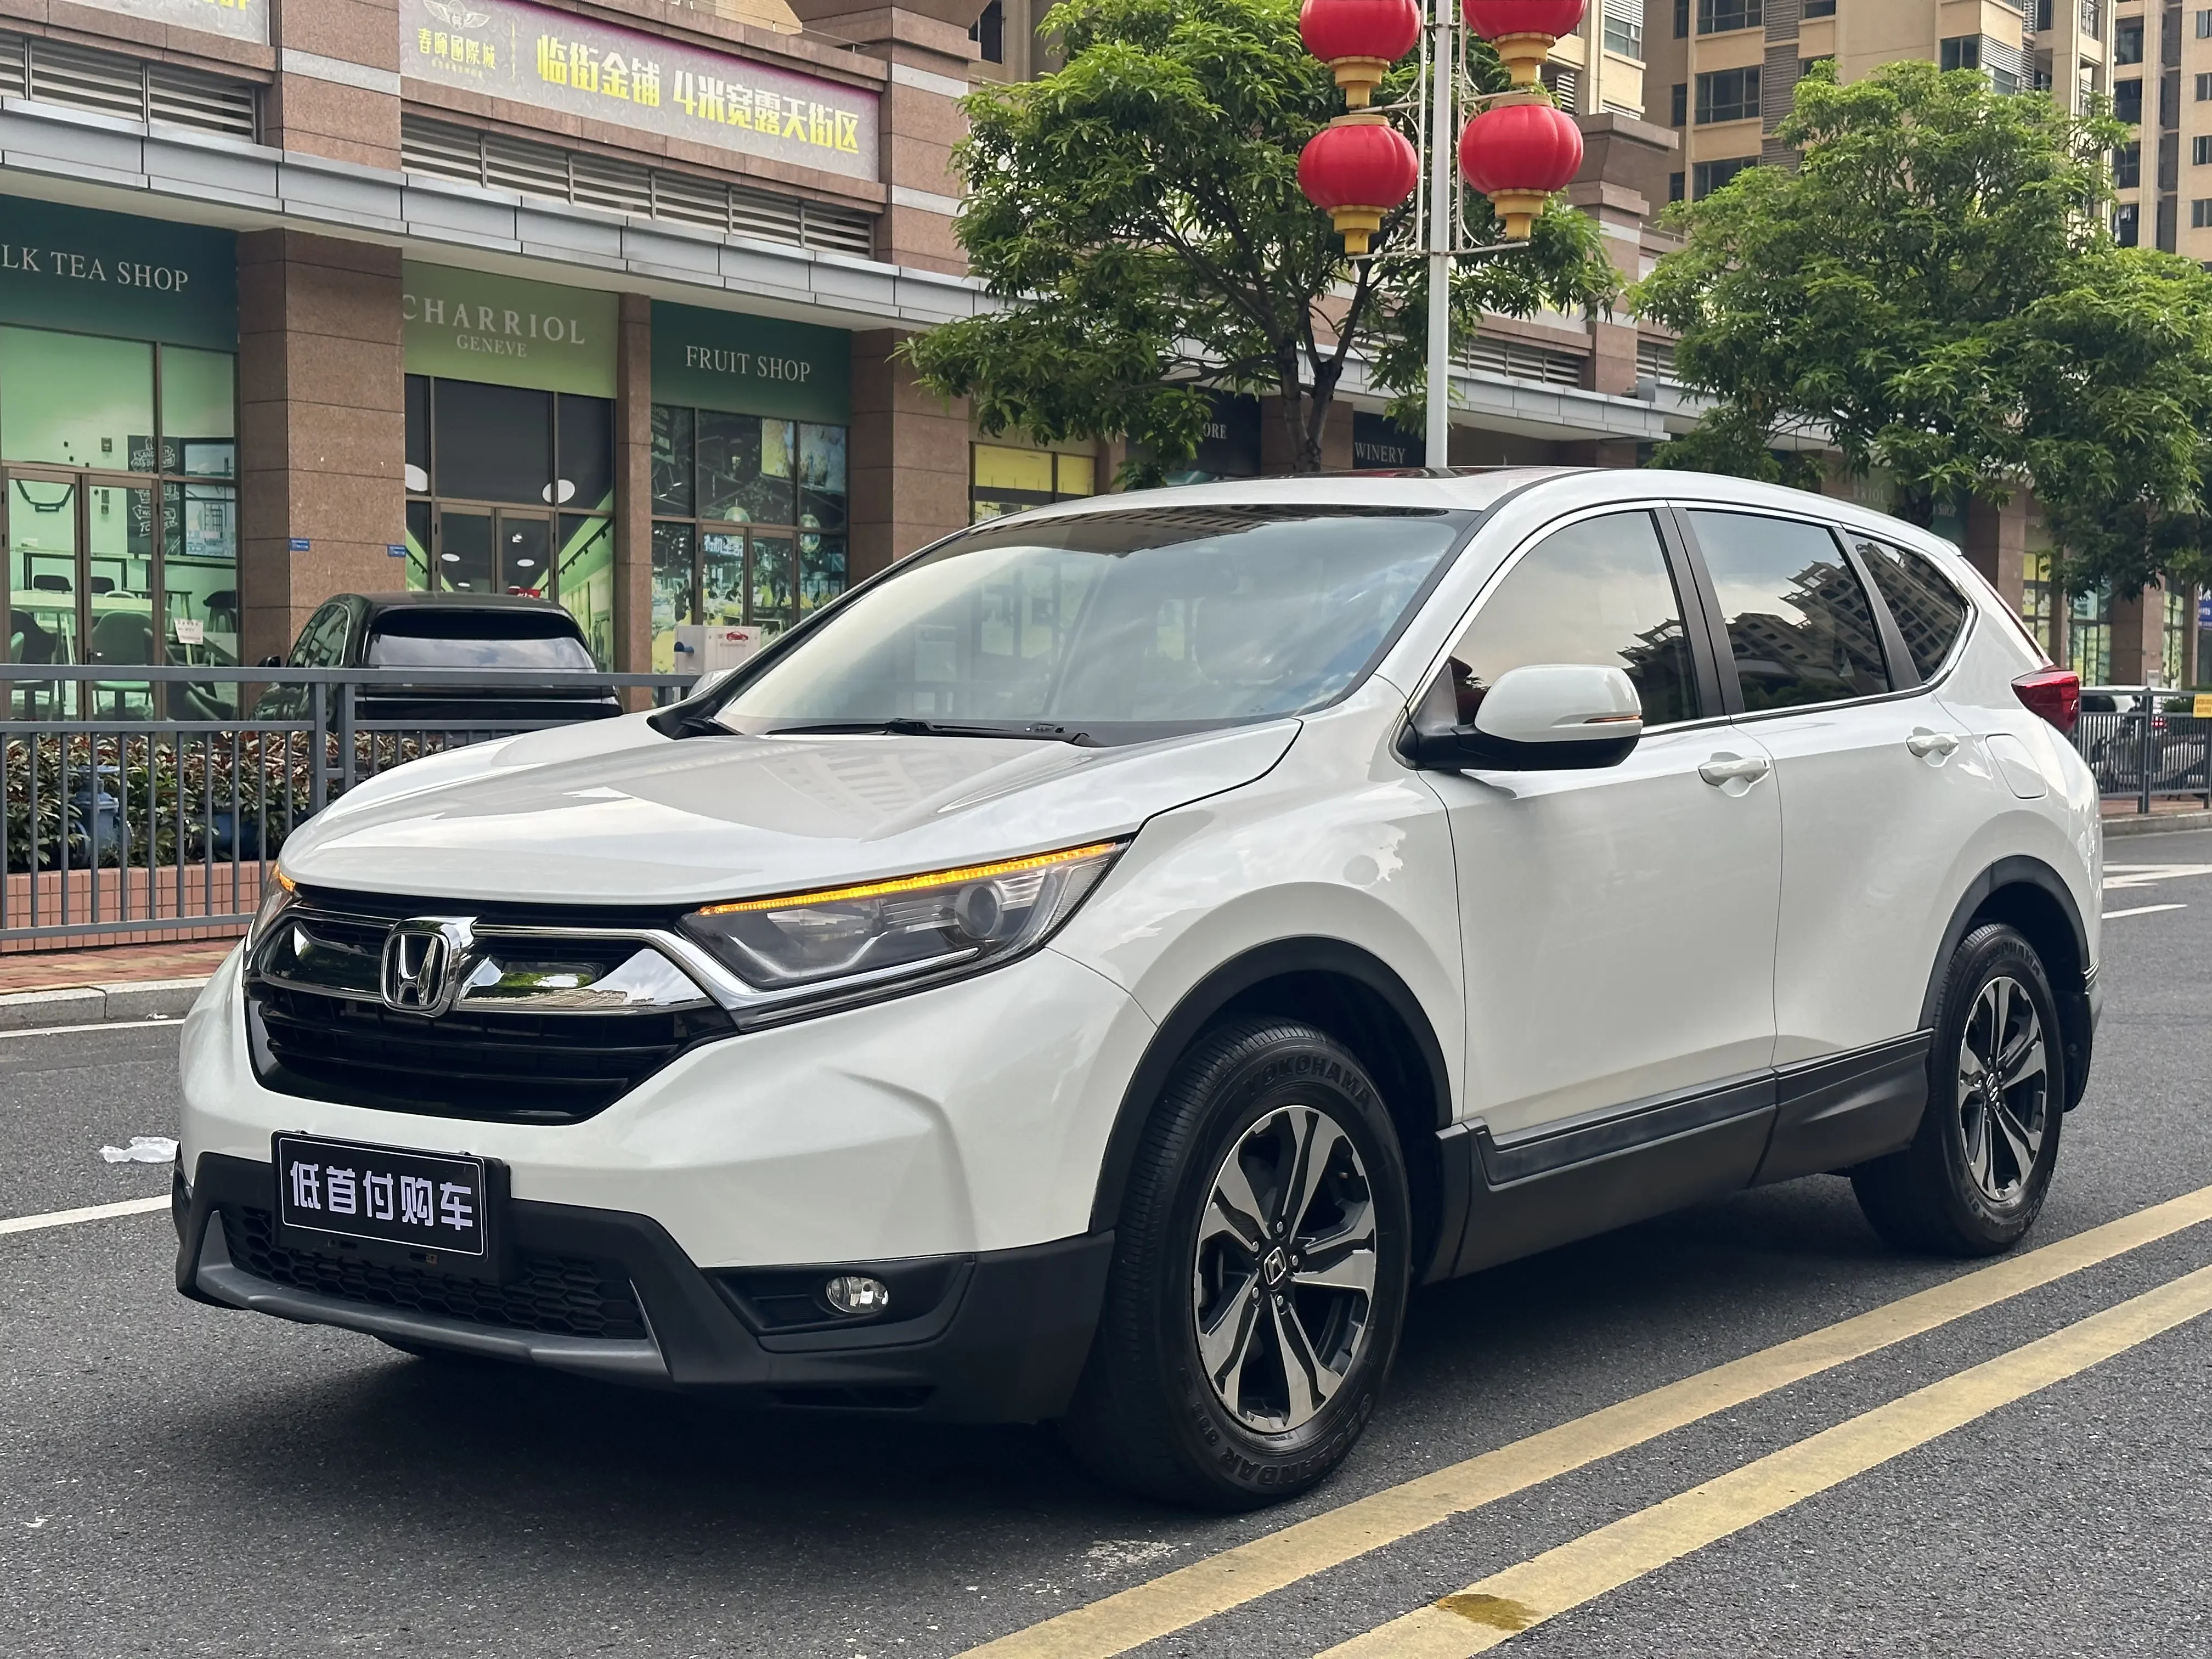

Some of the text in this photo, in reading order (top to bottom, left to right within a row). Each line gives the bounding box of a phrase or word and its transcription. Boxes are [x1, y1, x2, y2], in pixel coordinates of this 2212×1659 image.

[537, 35, 659, 107] 临街金铺
[673, 70, 859, 154] 4米宽露天街区
[1, 244, 188, 292] LK TEA SHOP
[403, 294, 585, 345] CHARRIOL
[456, 334, 527, 358] GENEVE
[686, 345, 810, 382] FRUIT SHOP
[1355, 442, 1406, 464] WINERY
[1242, 1054, 1372, 1113] YOKOHAMA
[290, 1161, 473, 1231] 低首付购车
